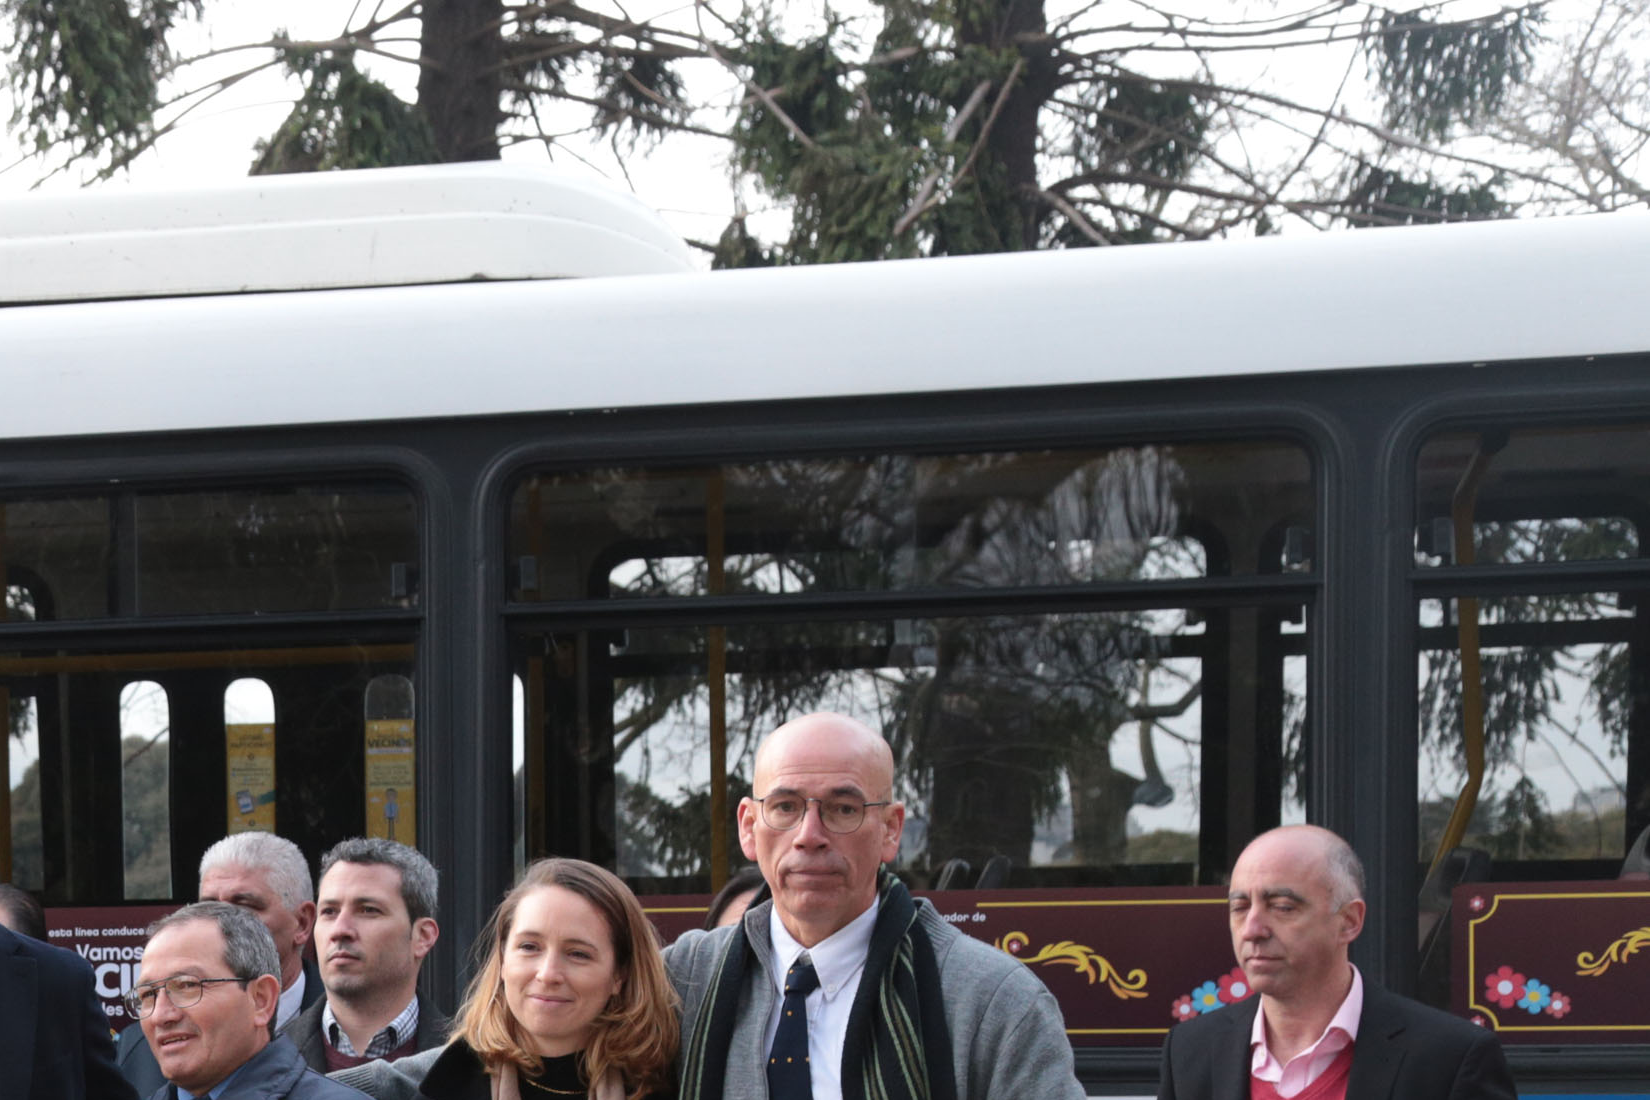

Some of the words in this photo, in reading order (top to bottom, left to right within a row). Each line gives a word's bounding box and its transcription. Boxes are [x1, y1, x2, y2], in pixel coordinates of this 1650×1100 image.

[972, 911, 986, 922] de
[48, 927, 72, 937] esta
[102, 925, 144, 936] conduce
[76, 943, 144, 961] Vamos
